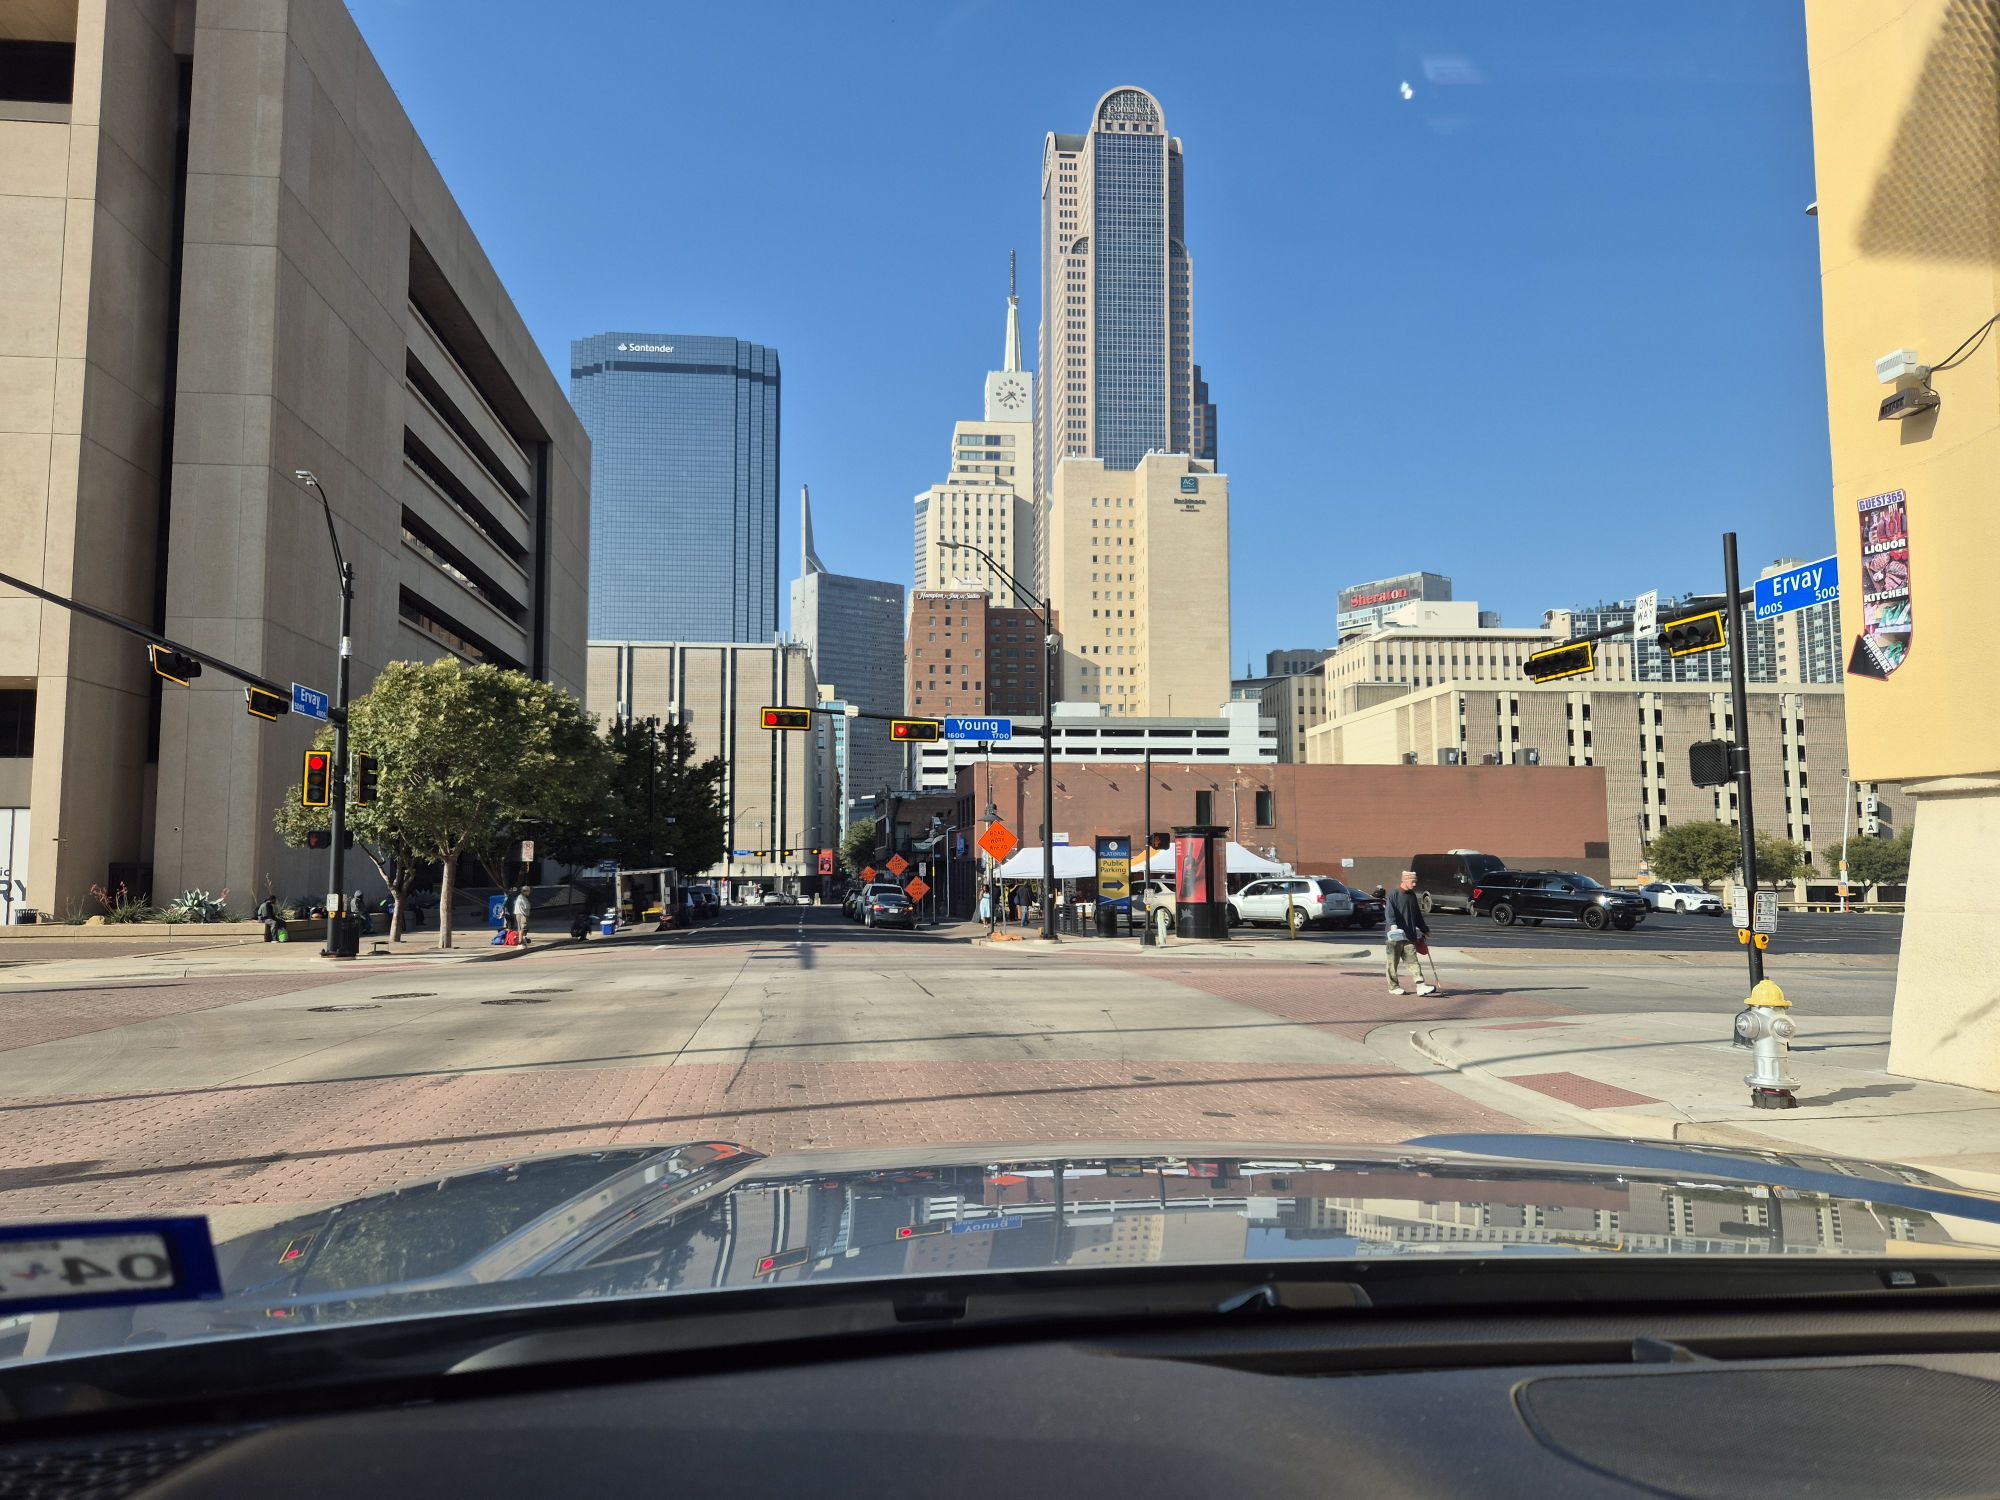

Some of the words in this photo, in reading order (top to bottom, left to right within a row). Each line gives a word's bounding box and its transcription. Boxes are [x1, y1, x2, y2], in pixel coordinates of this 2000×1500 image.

[629, 343, 674, 353] Santander
[1858, 491, 1903, 511] GUEST365
[1864, 538, 1906, 555] LIQUOR
[1773, 567, 1823, 597] Ervay
[916, 592, 944, 600] Hampton
[1350, 587, 1408, 608] Sheraton
[1639, 595, 1654, 610] ONE
[1863, 587, 1909, 603] KITCHEN
[1637, 608, 1654, 622] WAY
[1758, 601, 1783, 616] 400S
[1862, 633, 1893, 673] CONVENIENCE
[300, 688, 320, 710] Ervay
[957, 720, 998, 733] Young
